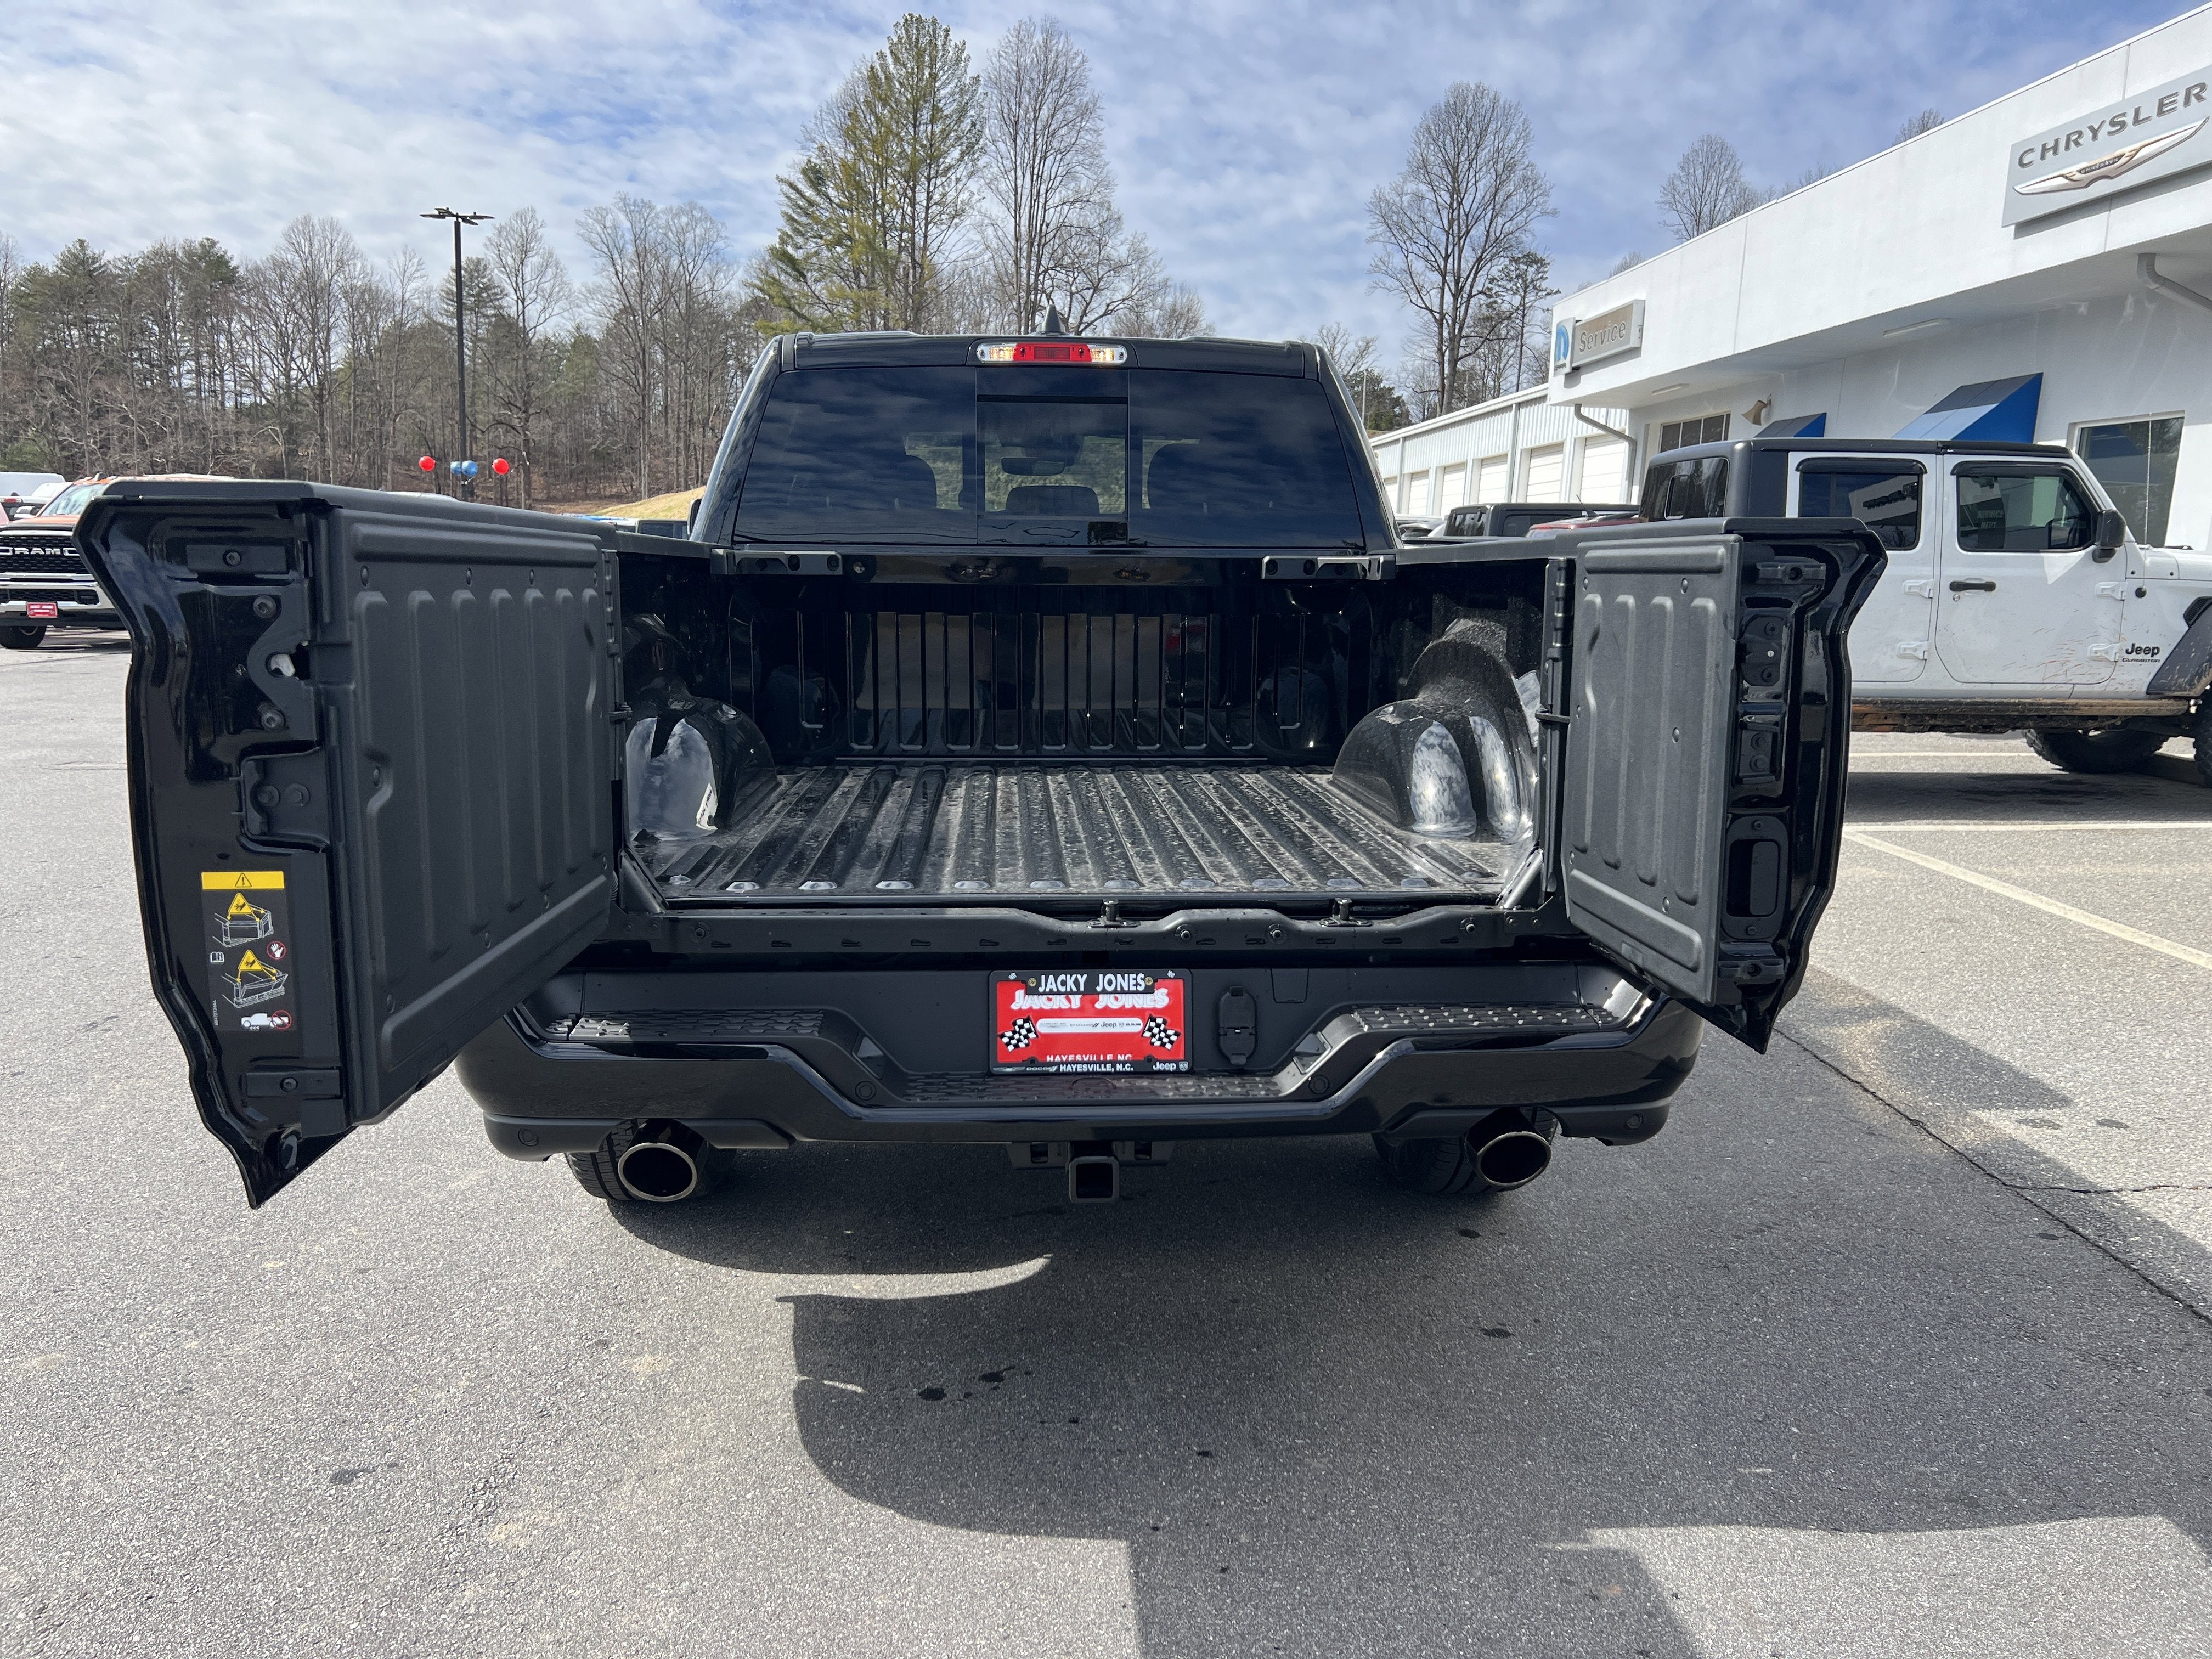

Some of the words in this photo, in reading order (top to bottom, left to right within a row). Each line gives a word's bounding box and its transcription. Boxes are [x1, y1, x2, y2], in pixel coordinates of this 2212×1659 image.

[2018, 82, 2208, 169] CHRYSLER
[1579, 320, 1626, 353] Service
[2125, 643, 2160, 657] Jeep
[1038, 974, 1087, 992] JACKY
[1096, 973, 1146, 991] JONES
[1011, 989, 1084, 1009] JACKY
[1094, 988, 1169, 1009] JONES
[1059, 1063, 1115, 1073] HAYESVILLE,
[1116, 1063, 1134, 1071] N.C.
[1153, 1061, 1177, 1072] Jeep
